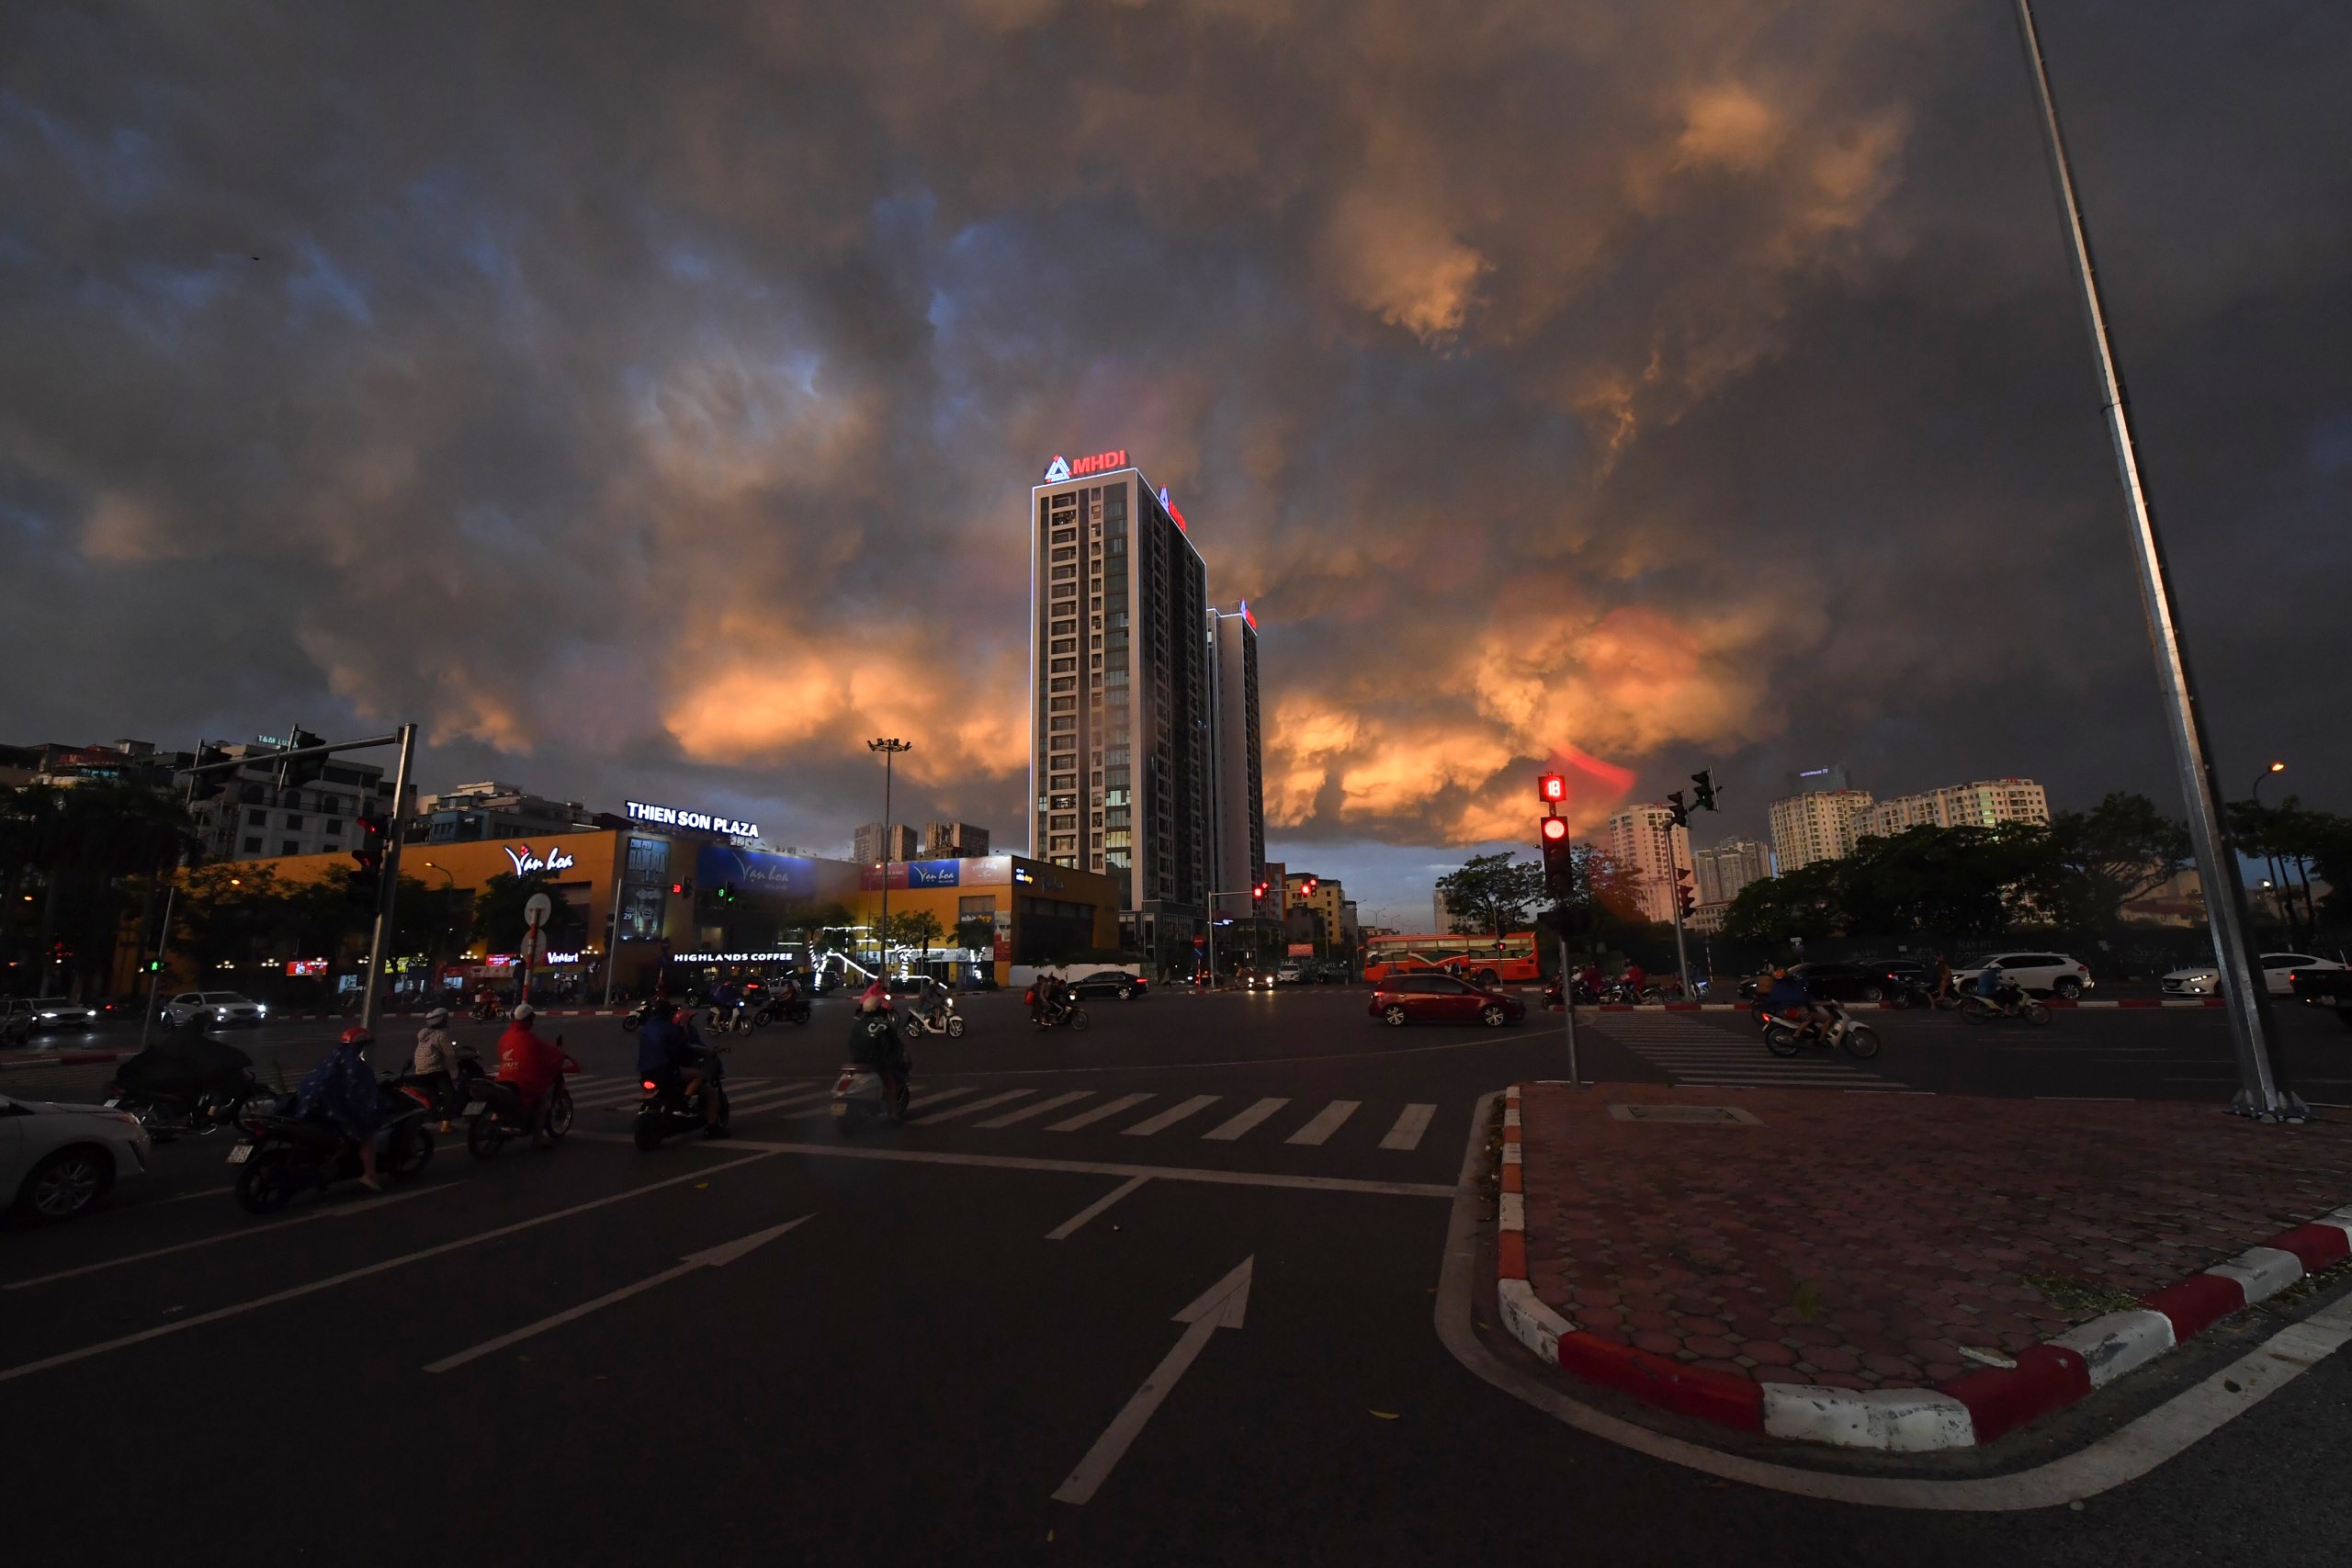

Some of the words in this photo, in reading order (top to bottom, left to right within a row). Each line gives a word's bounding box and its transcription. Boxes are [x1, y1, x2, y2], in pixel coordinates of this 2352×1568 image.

[1073, 450, 1125, 475] MHDI
[627, 801, 677, 824] THIEN
[677, 809, 711, 830] SON
[713, 817, 759, 838] PLAZA
[547, 847, 573, 870] hoa
[769, 865, 789, 882] hoa
[938, 869, 955, 880] hoa
[547, 952, 579, 964] VinMart
[673, 953, 749, 962] HIGHLANDS
[751, 953, 793, 961] COFFEE
